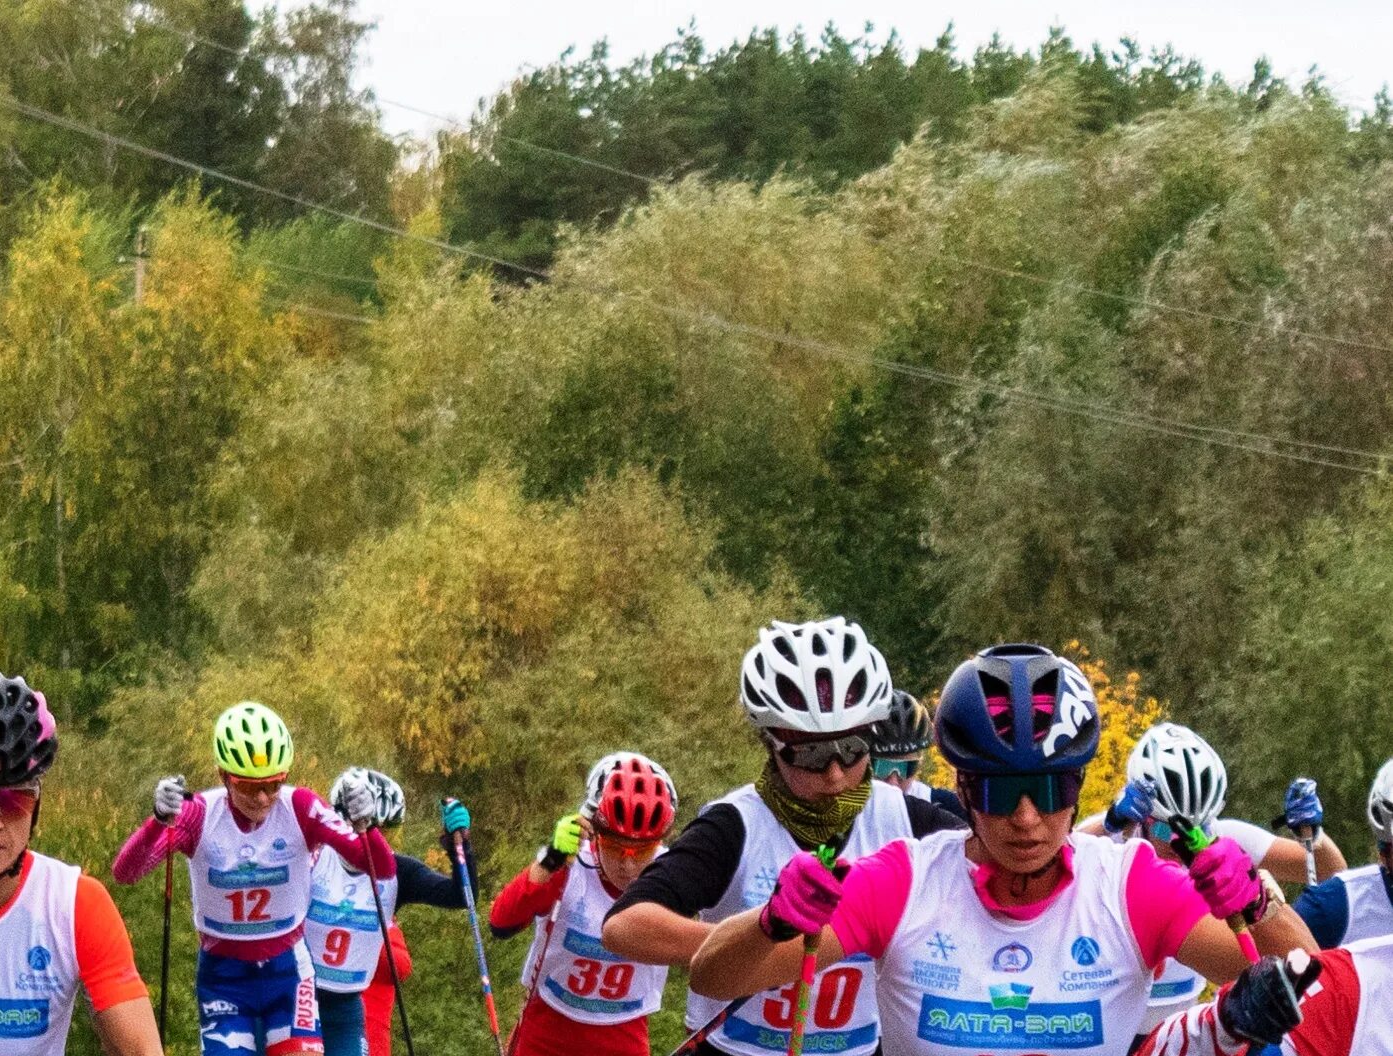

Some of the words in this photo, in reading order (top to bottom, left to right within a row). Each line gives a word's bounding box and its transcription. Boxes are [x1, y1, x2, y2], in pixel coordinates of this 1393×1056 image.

[224, 888, 272, 922] 12
[322, 928, 352, 968] 9
[566, 957, 636, 1000] 39
[1058, 977, 1120, 992] Компания
[1062, 968, 1113, 981] Сетевая
[297, 976, 314, 1031] RUSSIA
[927, 1008, 1094, 1035] ЯЛТА-ЗАЙ
[757, 1029, 850, 1050] ЗАНСК
